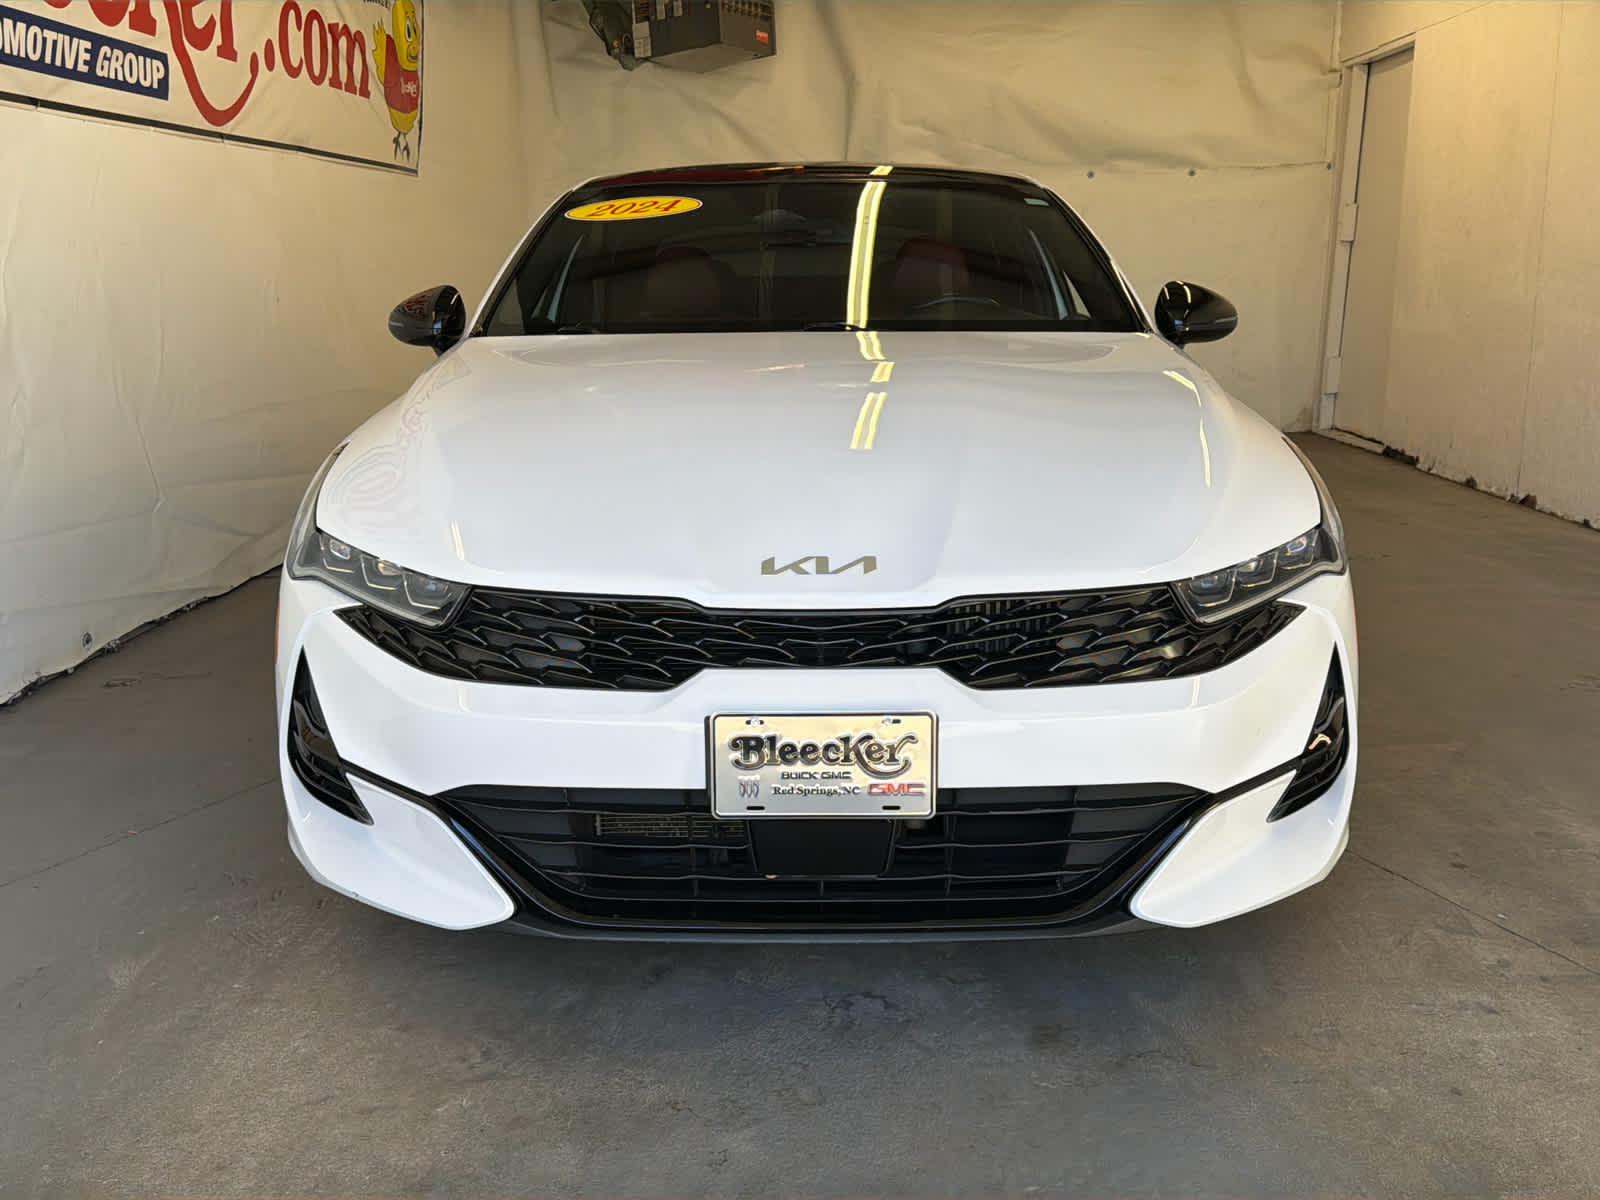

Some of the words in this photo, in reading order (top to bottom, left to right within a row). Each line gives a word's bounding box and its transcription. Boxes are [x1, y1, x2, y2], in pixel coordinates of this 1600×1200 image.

[0, 17, 91, 73] MOTIVE
[95, 45, 165, 89] GROUP
[586, 199, 681, 217] 2024
[761, 556, 877, 575] KIA
[780, 771, 817, 780] BUICK
[820, 771, 852, 780] GMC
[773, 785, 795, 796] Red
[868, 783, 926, 797] GMC
